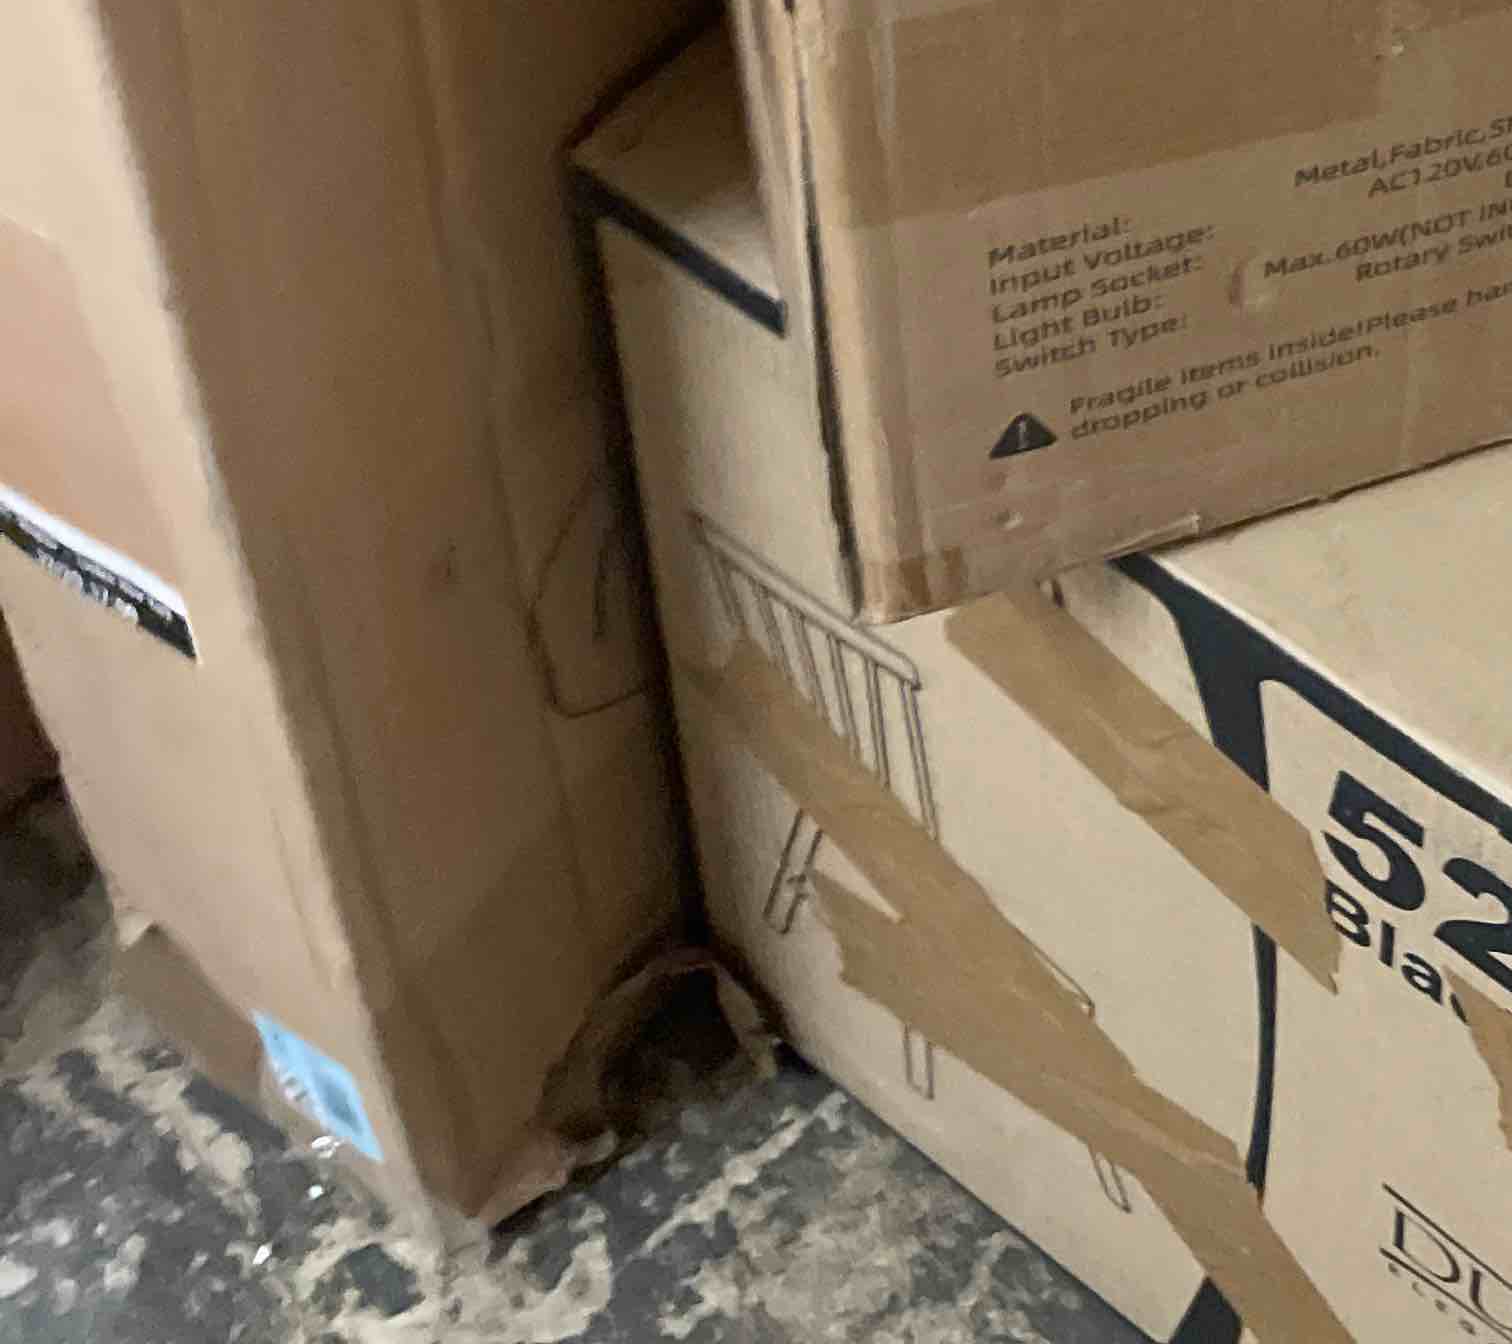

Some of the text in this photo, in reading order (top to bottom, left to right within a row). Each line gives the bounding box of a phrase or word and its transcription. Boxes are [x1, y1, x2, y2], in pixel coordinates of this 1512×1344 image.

[988, 217, 1132, 269] Material:
[989, 224, 1216, 296] Input Voltage:
[1356, 240, 1453, 284] Rotary
[992, 255, 1204, 325] Lamp Socket:
[993, 294, 1166, 351] Light Bulb:
[994, 313, 1188, 380] Switch Type:
[1068, 374, 1172, 415] Fragile
[1179, 350, 1262, 386] items
[1071, 388, 1209, 442] dropping
[1217, 379, 1246, 400] or
[1326, 878, 1469, 1024] Bla
